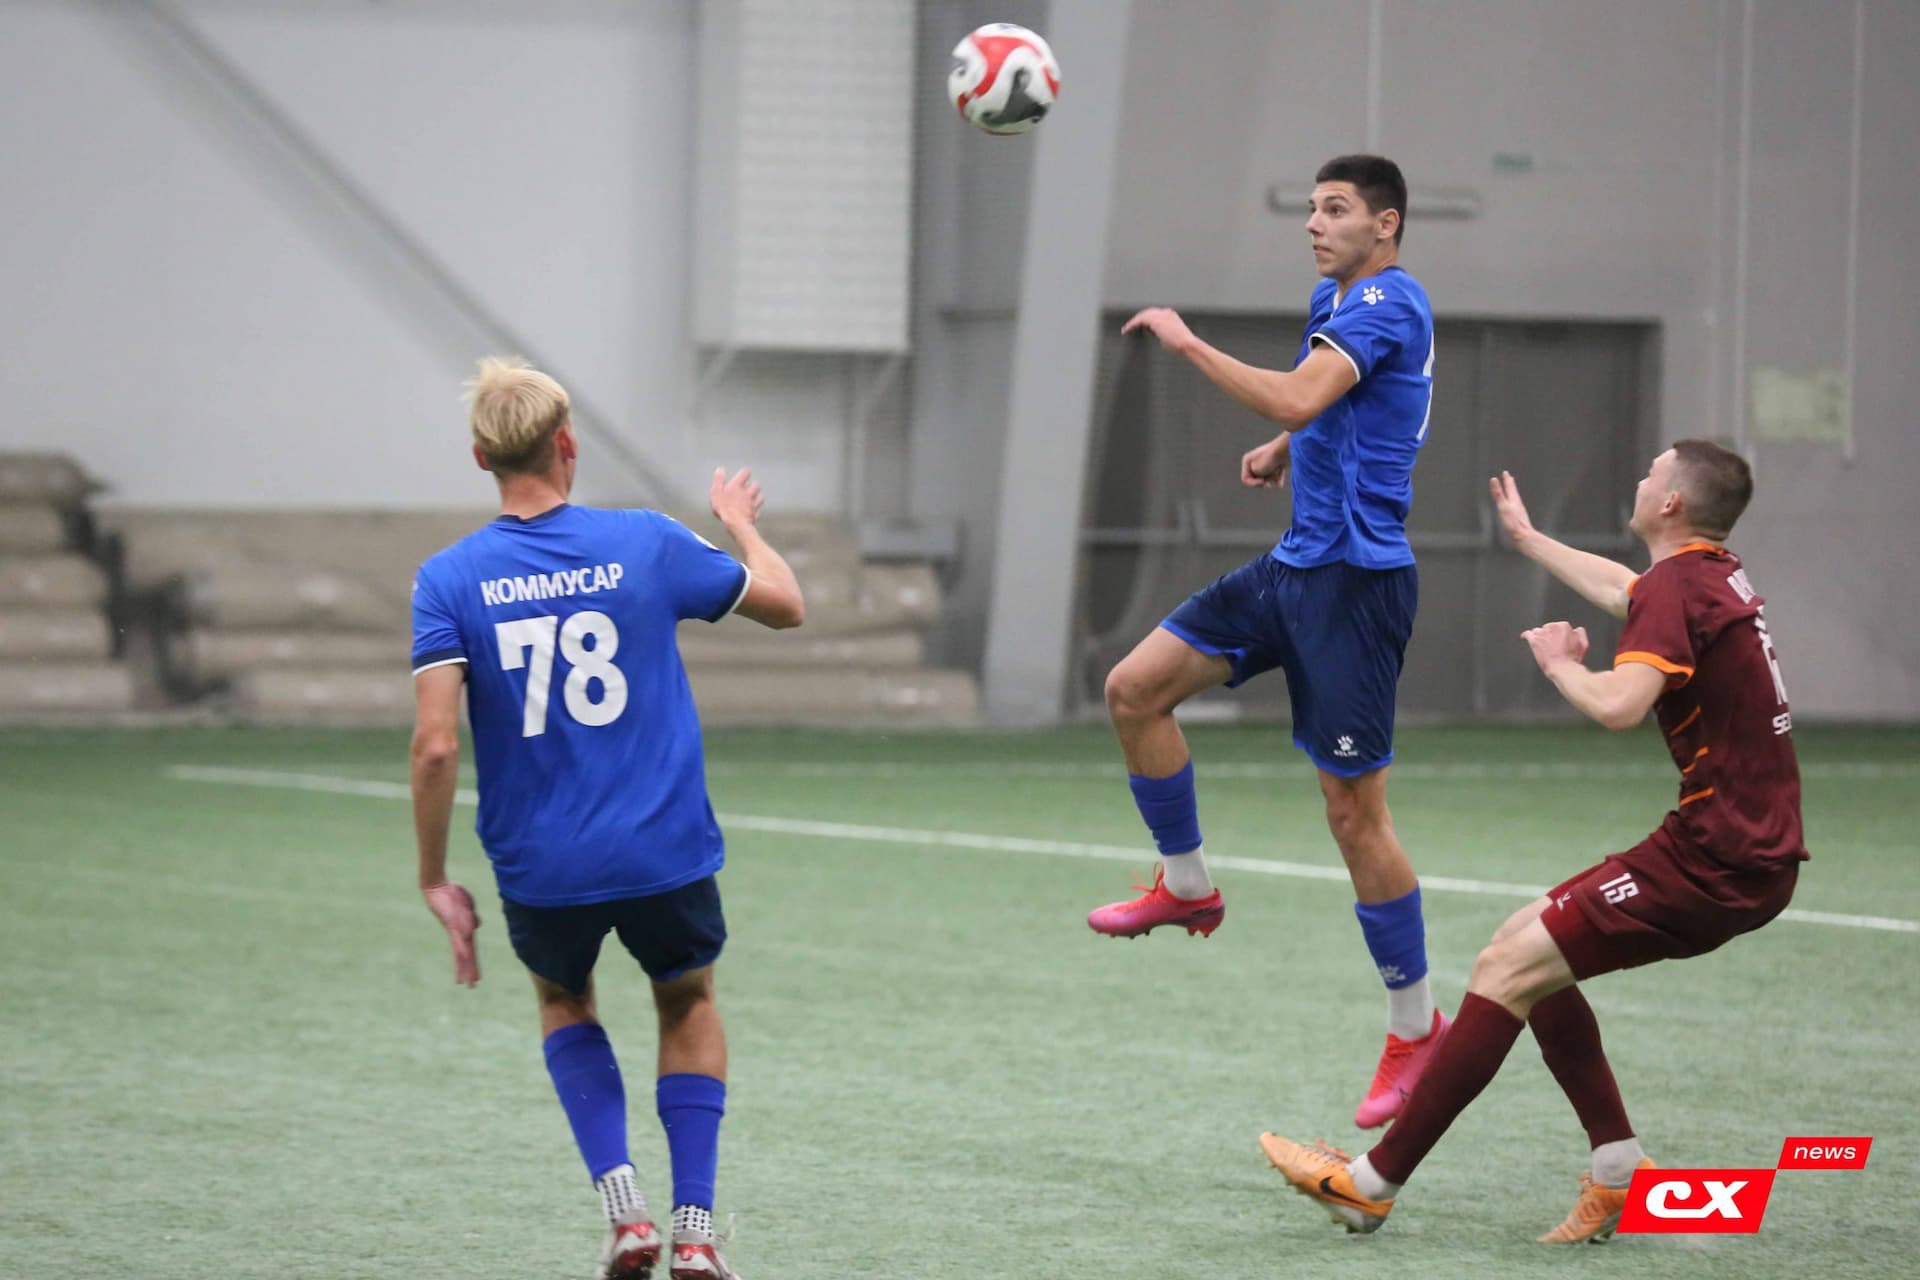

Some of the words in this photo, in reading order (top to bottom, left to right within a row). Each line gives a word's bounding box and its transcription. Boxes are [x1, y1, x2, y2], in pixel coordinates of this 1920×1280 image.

[480, 563, 624, 606] КОММУСАР
[494, 610, 628, 738] 78
[1598, 872, 1640, 905] 15
